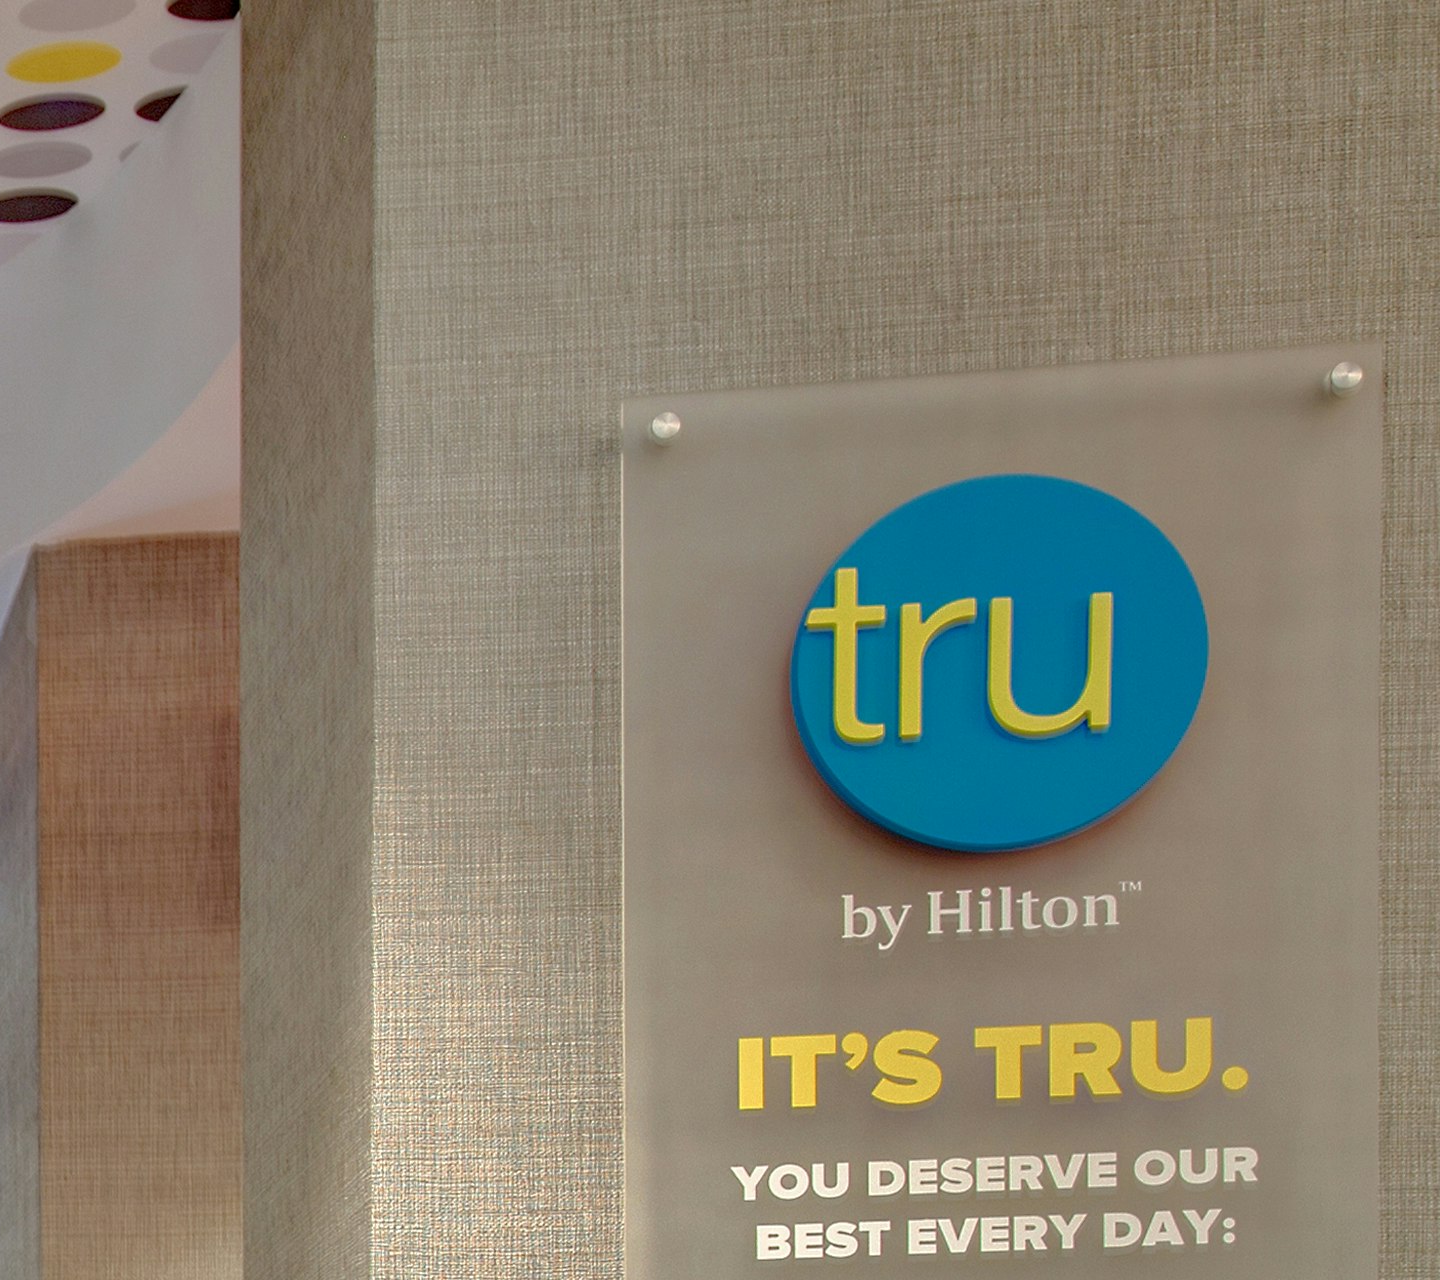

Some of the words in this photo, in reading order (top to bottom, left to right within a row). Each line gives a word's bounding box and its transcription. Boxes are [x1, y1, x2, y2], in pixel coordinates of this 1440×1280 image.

[807, 569, 1112, 742] tru
[842, 895, 911, 950] by
[739, 1030, 943, 1110] IT'S
[975, 1017, 1248, 1100] TRU.
[731, 1163, 849, 1200] YOU
[868, 1153, 1117, 1196] DESERVE
[1134, 1147, 1258, 1185] OUR
[757, 1221, 890, 1259] BEST
[908, 1214, 1086, 1254] EVERY
[1104, 1209, 1235, 1247] DAY:
